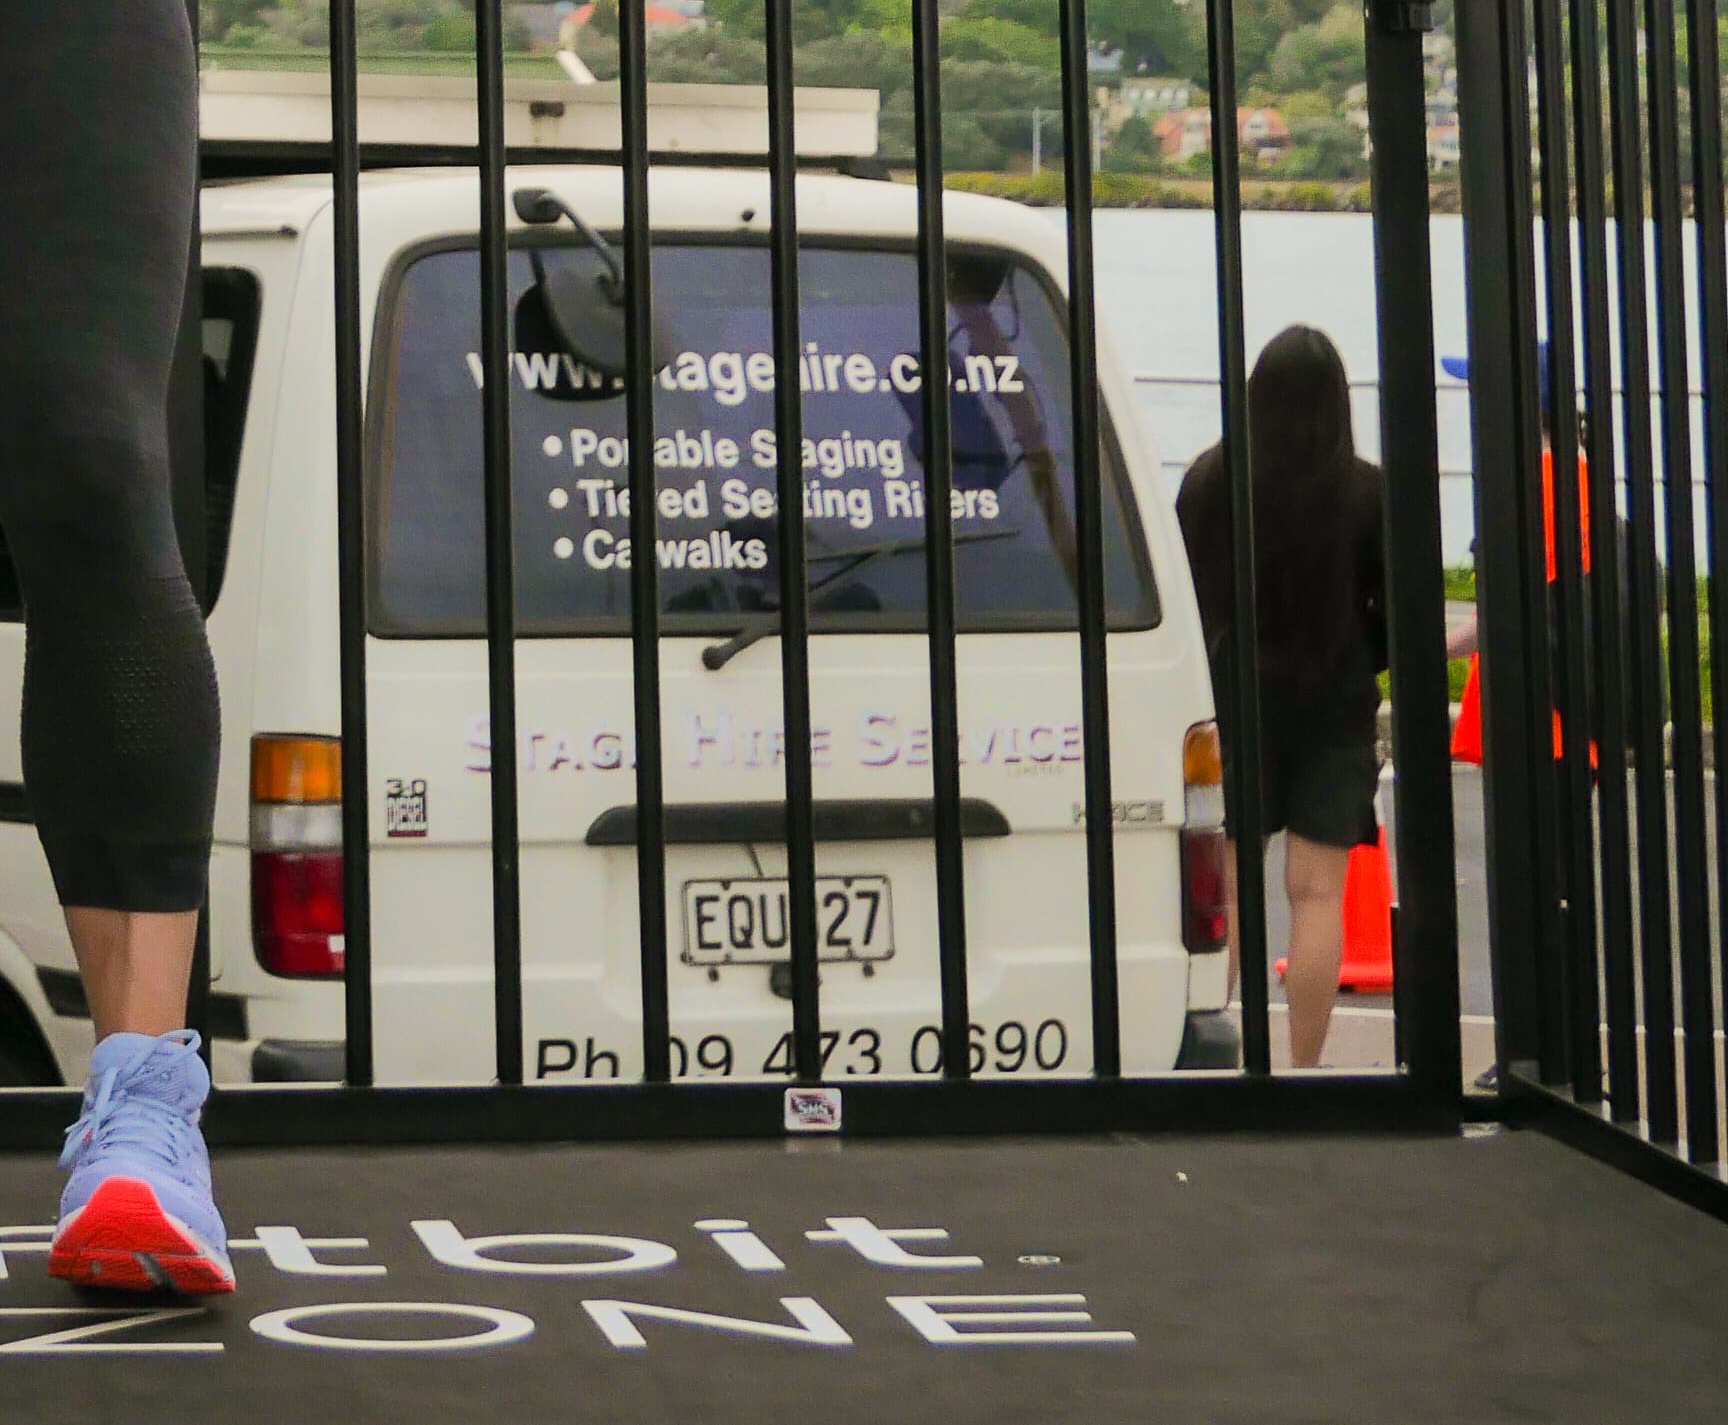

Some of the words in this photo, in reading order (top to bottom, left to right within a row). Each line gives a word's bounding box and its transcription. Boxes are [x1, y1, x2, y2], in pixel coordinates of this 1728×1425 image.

[569, 427, 740, 469] Poable
[751, 428, 905, 479] Saging
[576, 478, 710, 519] Tieed
[720, 478, 873, 530] Seting
[582, 527, 769, 571] Cawalks
[858, 712, 1082, 768] SEVICE
[694, 890, 882, 951] EQU27
[535, 1037, 620, 1079] Ph
